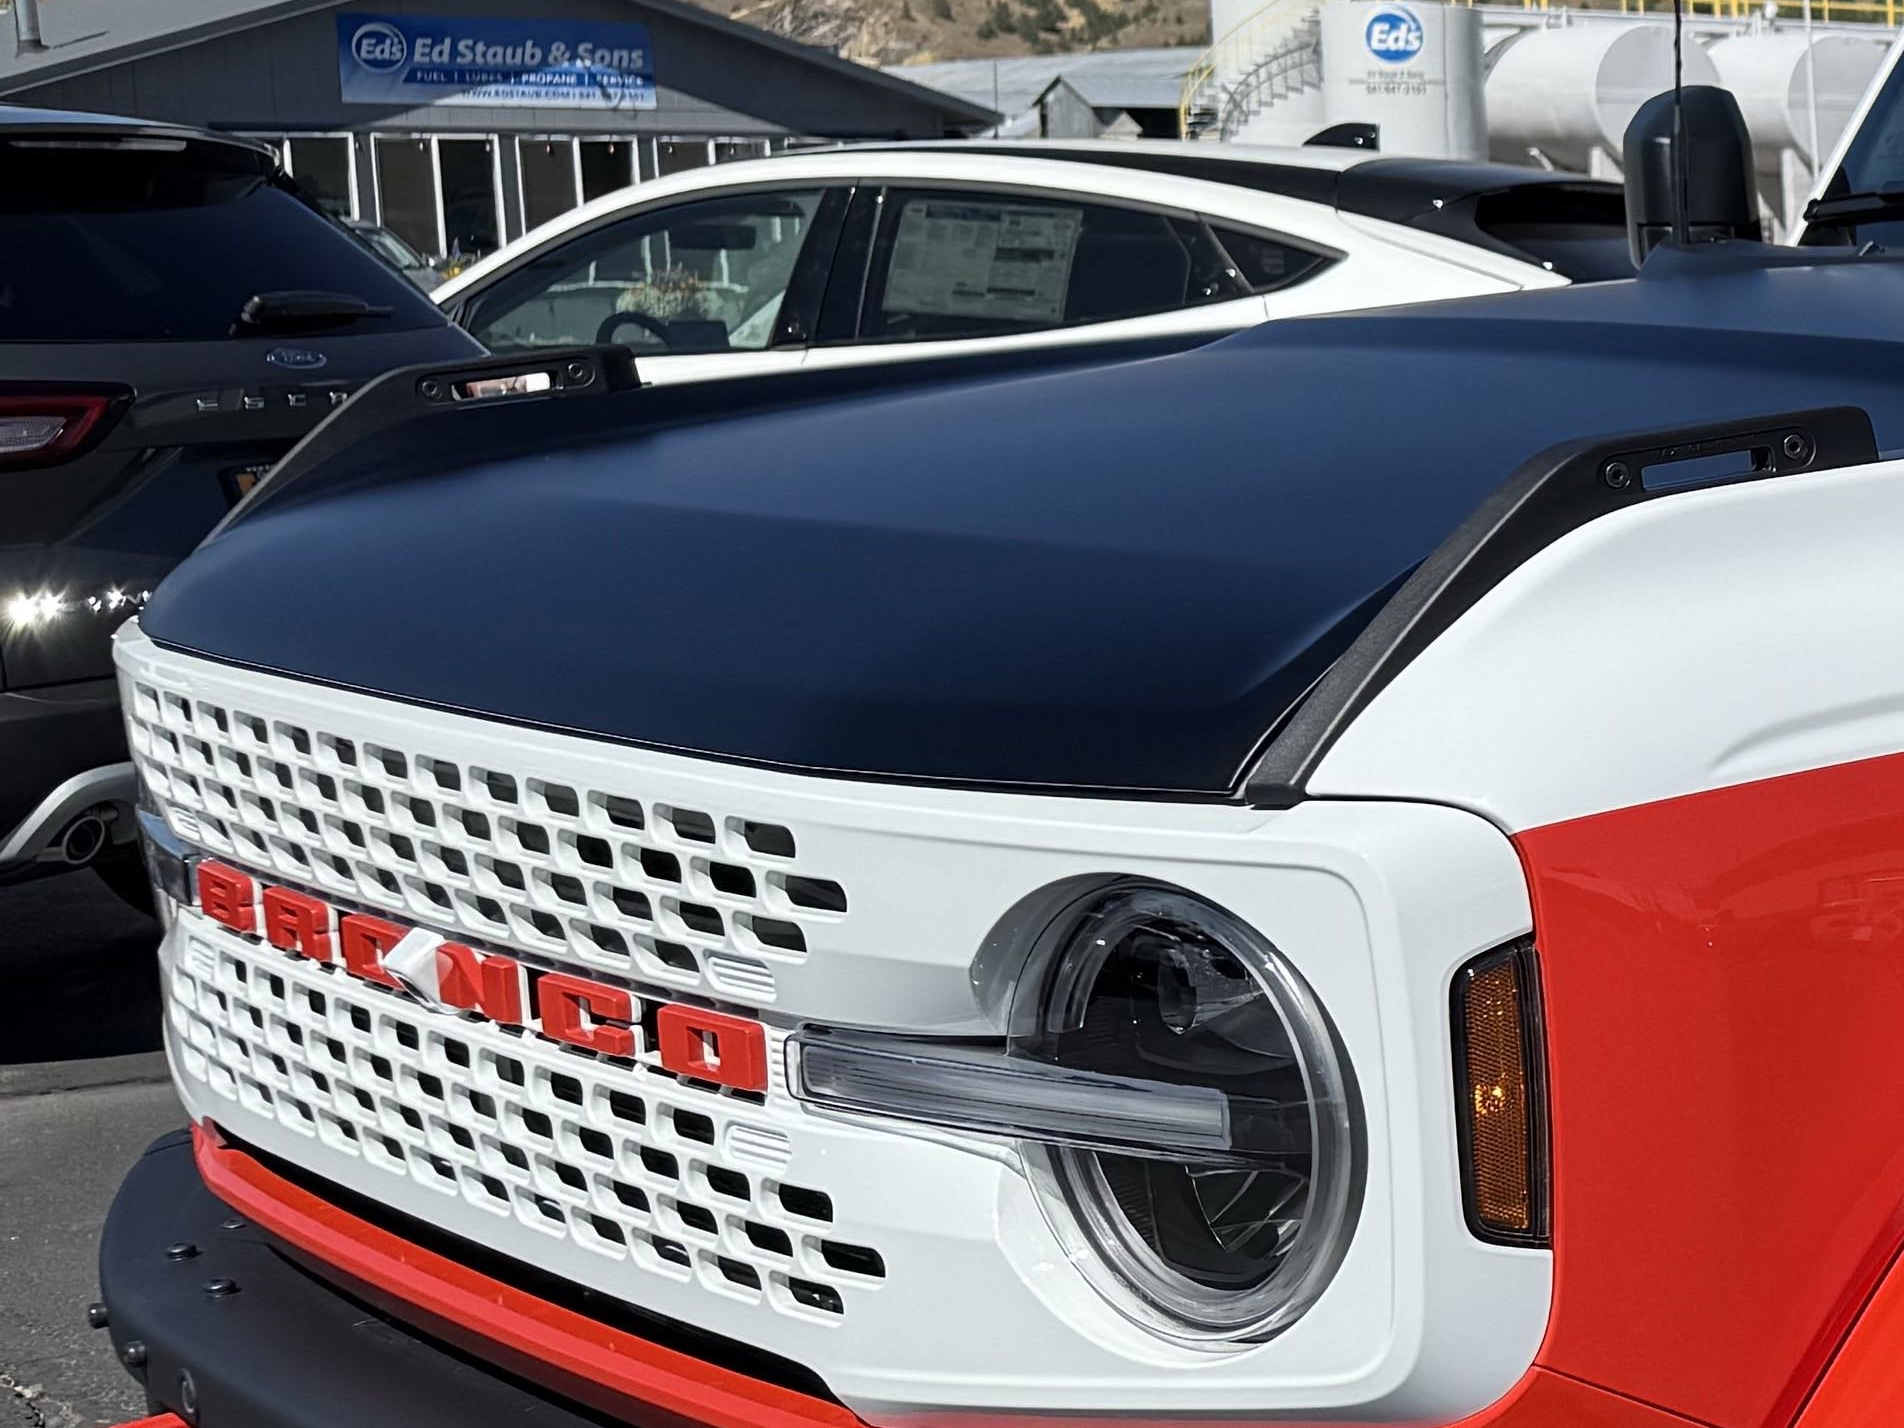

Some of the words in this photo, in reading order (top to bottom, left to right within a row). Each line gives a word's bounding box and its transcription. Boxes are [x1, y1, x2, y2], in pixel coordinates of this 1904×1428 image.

[414, 38, 451, 64] Ed
[456, 39, 543, 67] Staub
[548, 42, 571, 67] &
[577, 42, 644, 70] Sons
[416, 71, 447, 82] FUEL
[199, 859, 769, 1092] BRONCO
